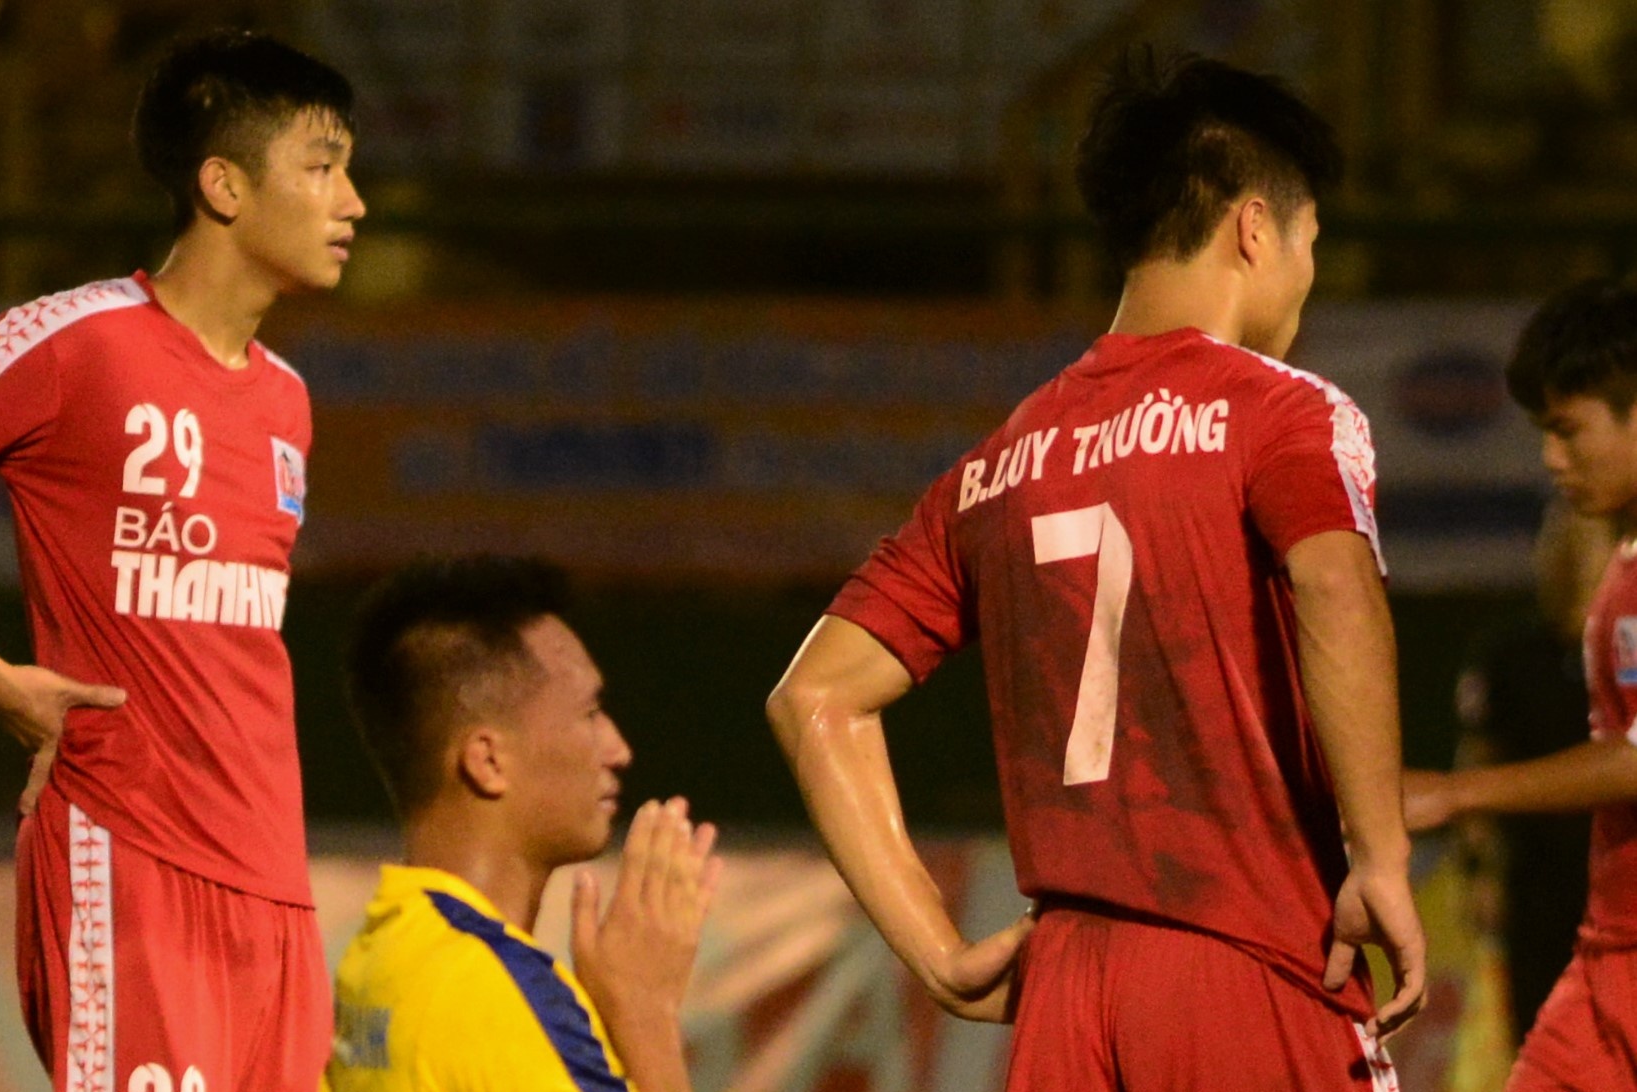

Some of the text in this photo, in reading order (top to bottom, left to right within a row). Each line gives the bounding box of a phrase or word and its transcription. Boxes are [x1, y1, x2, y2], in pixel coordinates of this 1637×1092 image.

[122, 403, 204, 498] 29
[1073, 388, 1229, 475] THƯỜNG
[114, 501, 218, 556] BÁO
[1031, 502, 1133, 786] 7
